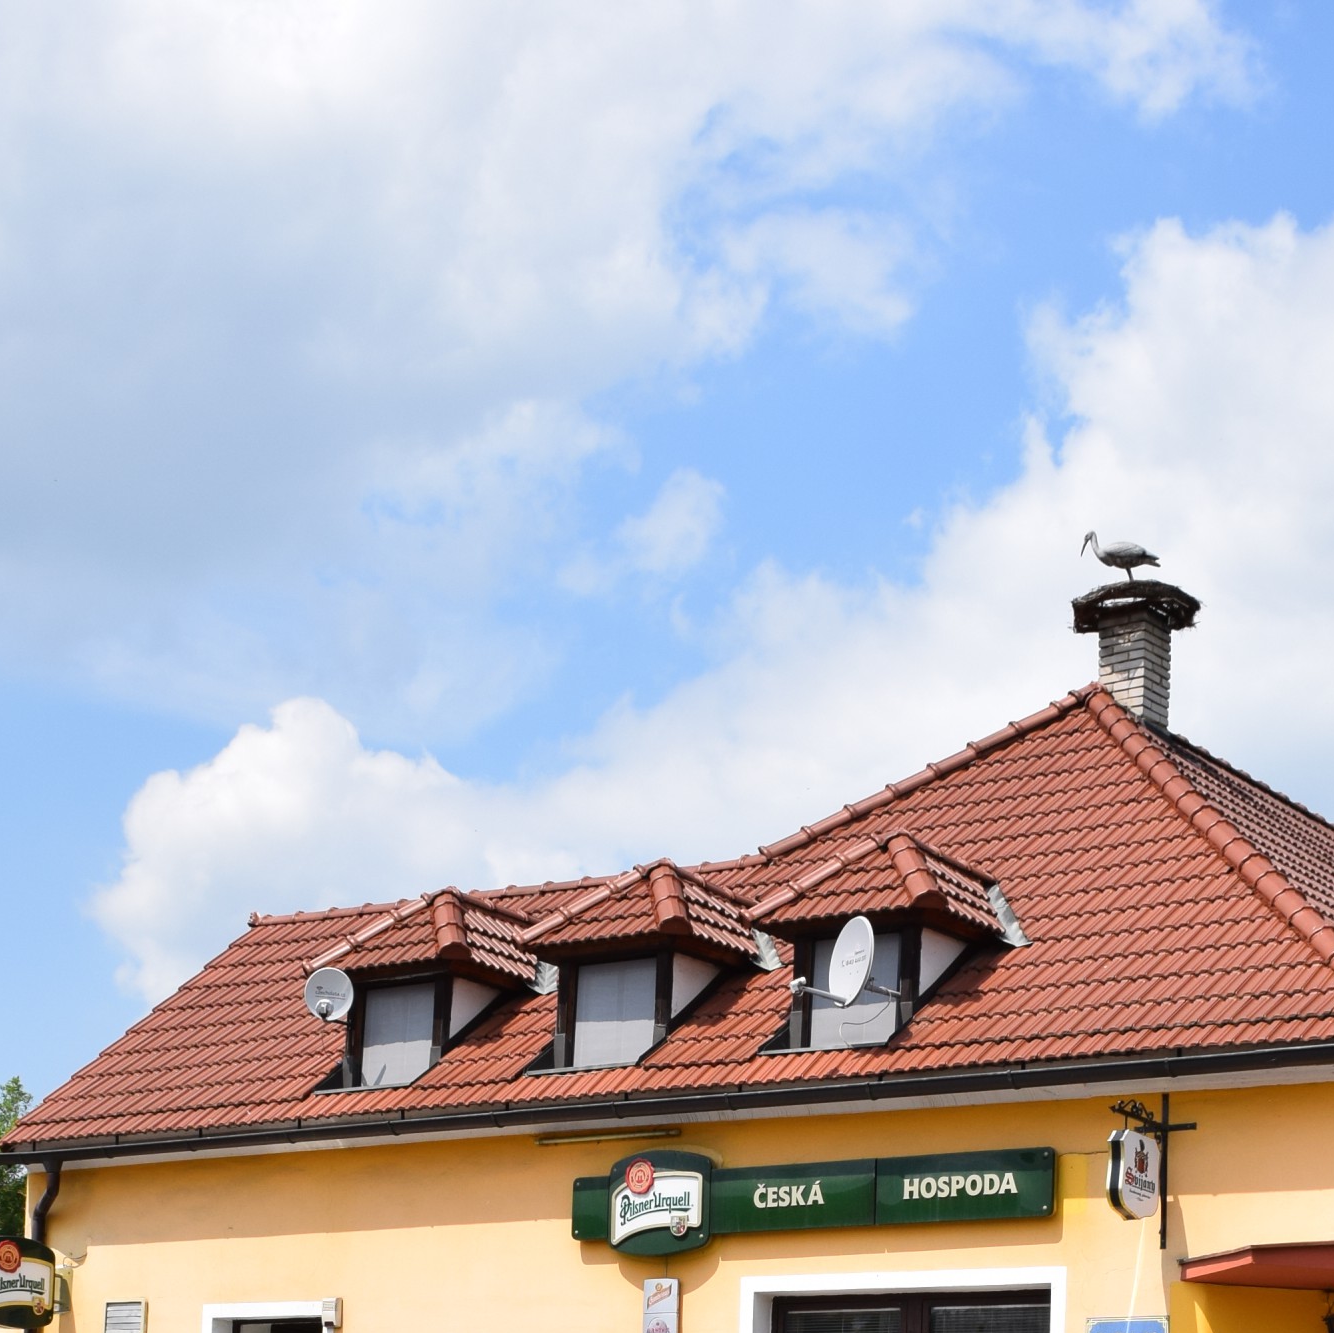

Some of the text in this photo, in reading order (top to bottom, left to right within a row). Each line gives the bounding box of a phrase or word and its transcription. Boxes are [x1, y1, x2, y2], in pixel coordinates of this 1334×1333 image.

[753, 1172, 1018, 1209] ČESKÁ HOSPODA
[620, 1191, 691, 1226] Pilsner Urquell
[18, 1273, 45, 1295] Urquell
